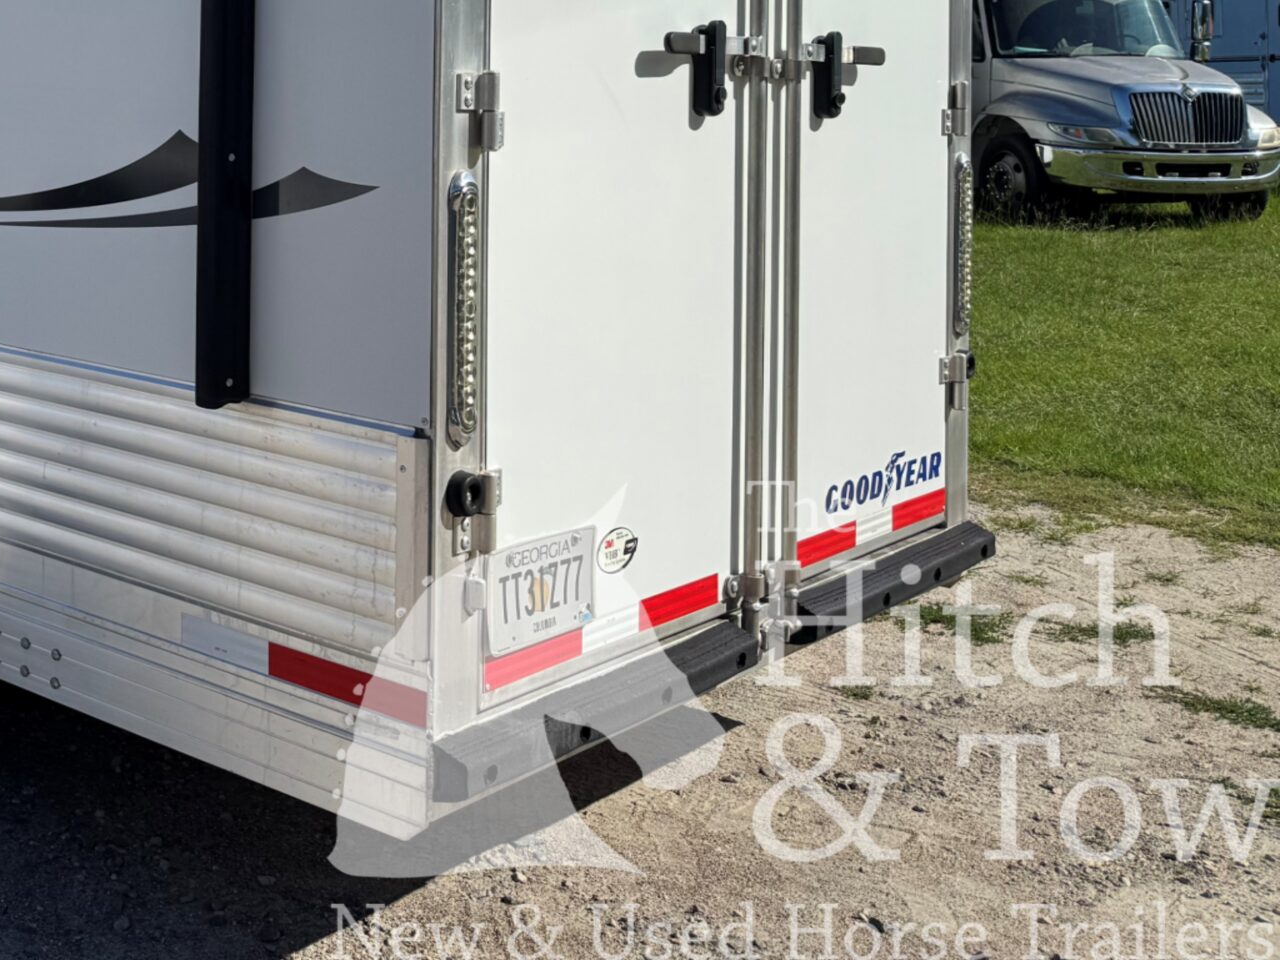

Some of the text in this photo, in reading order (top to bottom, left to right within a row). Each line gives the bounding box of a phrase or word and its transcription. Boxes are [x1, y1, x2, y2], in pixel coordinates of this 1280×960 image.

[825, 450, 942, 514] GOODYEAR
[511, 539, 571, 569] GEORGIA
[499, 554, 584, 624] TT31Z77
